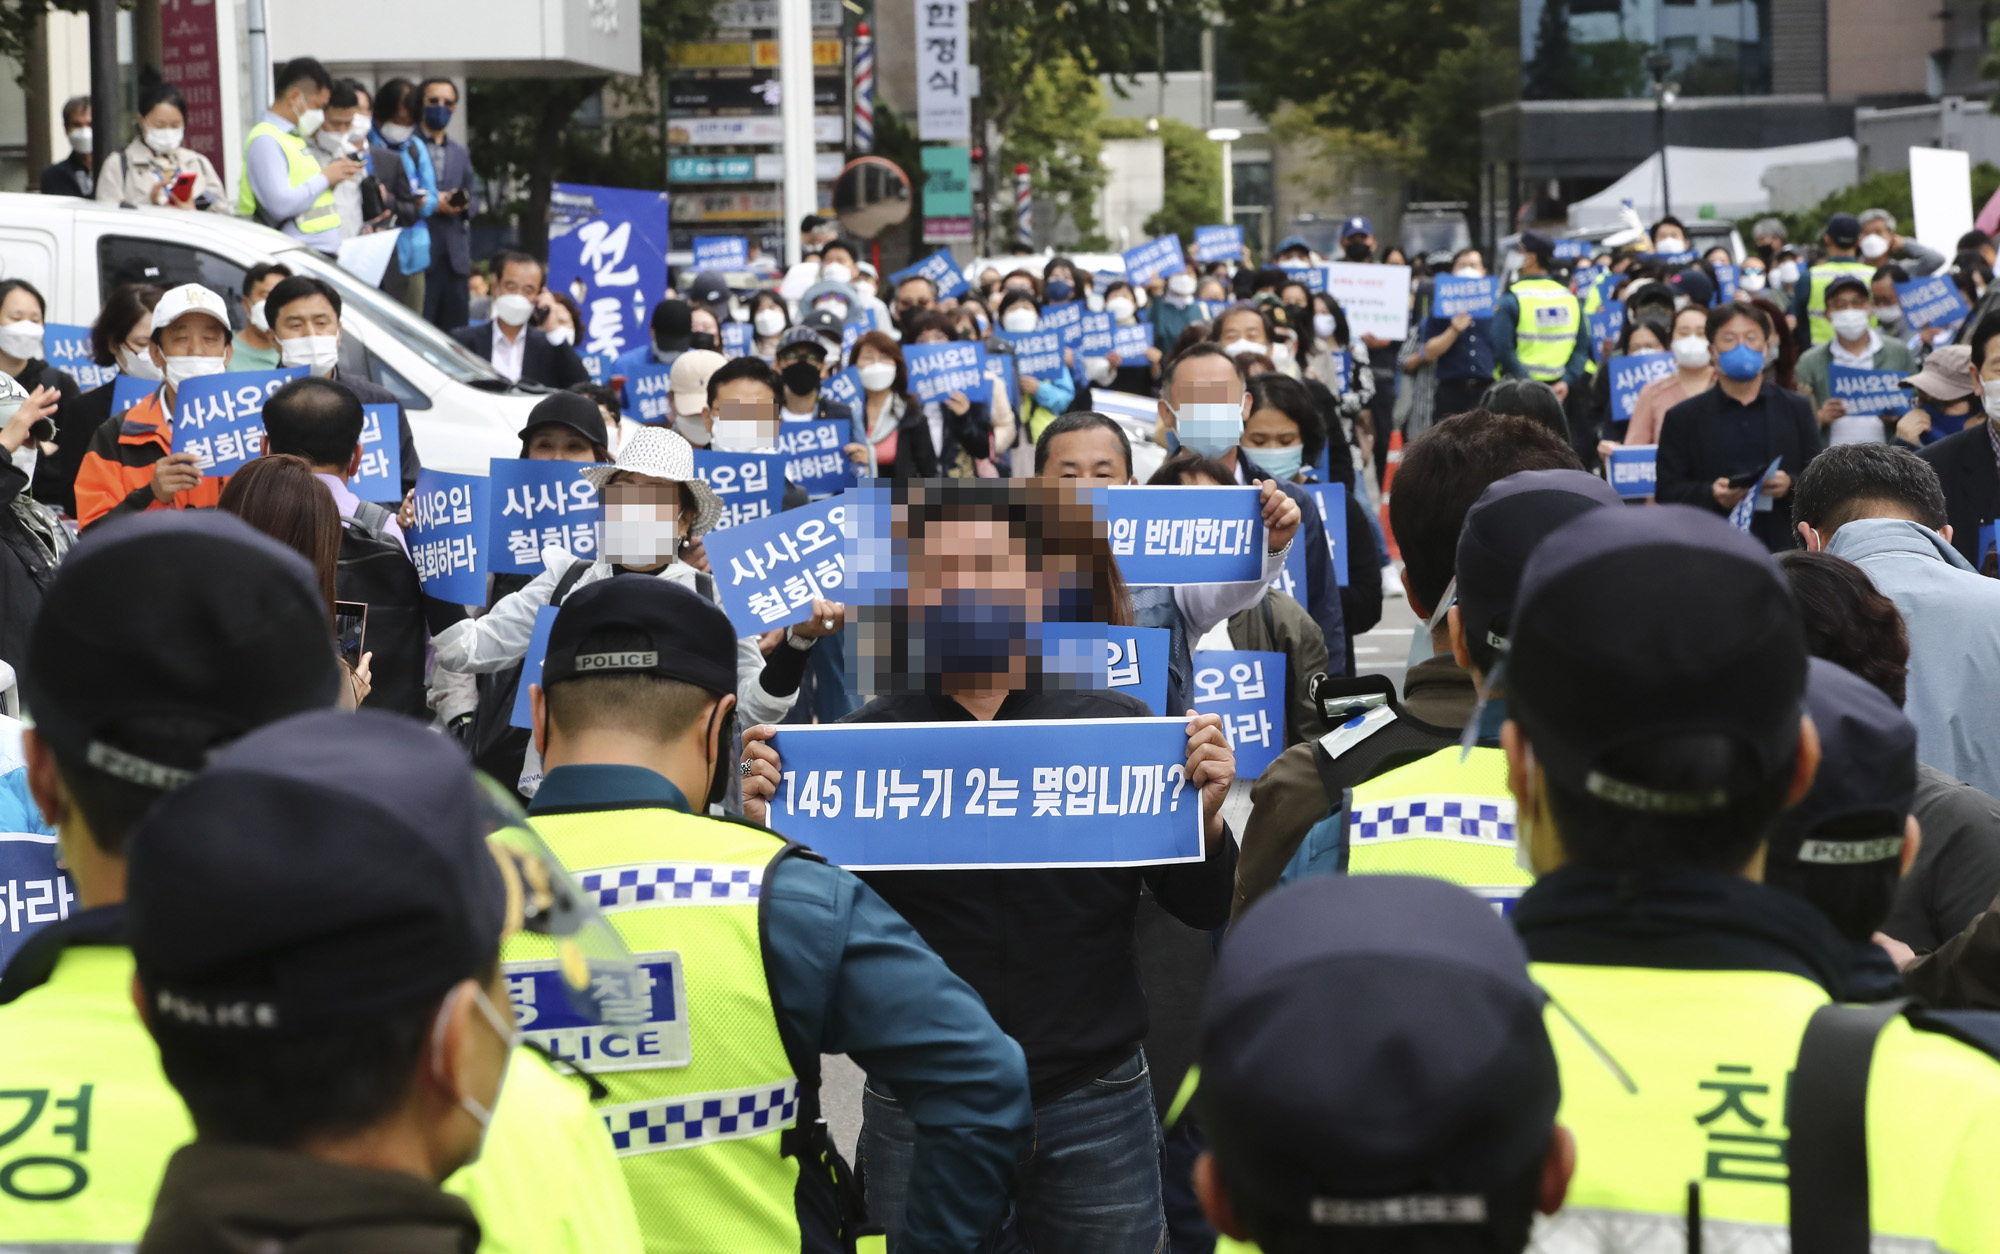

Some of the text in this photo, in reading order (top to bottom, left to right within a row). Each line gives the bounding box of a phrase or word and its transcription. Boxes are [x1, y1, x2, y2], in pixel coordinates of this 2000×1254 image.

[925, 2, 959, 97] 한정식
[910, 345, 979, 376] 사사오입
[697, 460, 769, 494] 오입
[1108, 517, 1255, 557] 입 반대한다!
[582, 653, 654, 669] POLICE
[783, 763, 1187, 821] 145 나누기 2는 몇입니까?
[1811, 839, 1897, 862] POLICE
[549, 1030, 661, 1063] LICE
[0, 1083, 95, 1202] 경
